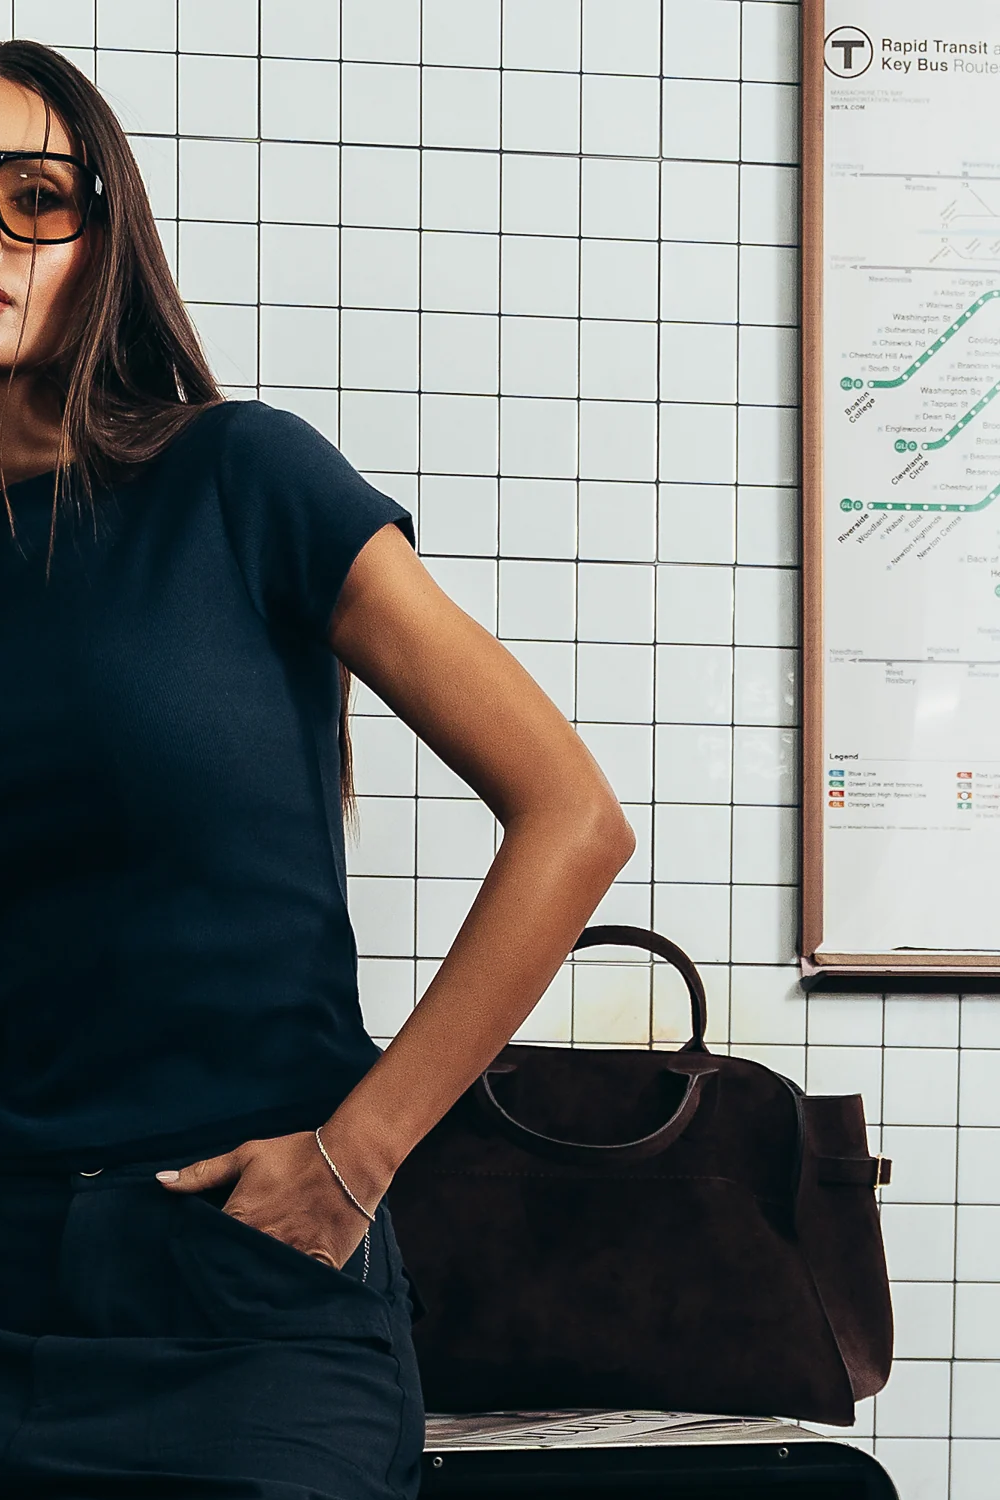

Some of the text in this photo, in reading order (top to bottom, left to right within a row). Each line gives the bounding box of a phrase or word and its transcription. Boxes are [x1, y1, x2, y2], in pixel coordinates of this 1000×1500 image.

[831, 40, 865, 69] T
[881, 38, 928, 55] Rapid
[933, 40, 988, 54] Transit
[881, 57, 912, 73] Key
[918, 58, 948, 72] Bus
[893, 314, 939, 323] Washington
[844, 391, 870, 416] Boston
[849, 398, 876, 424] College
[891, 453, 924, 486] Cleveland
[909, 460, 930, 480] Circle
[837, 513, 870, 544] Riverside
[856, 513, 889, 545] Woodland
[916, 537, 939, 559] Newton
[829, 753, 859, 761] Legend
